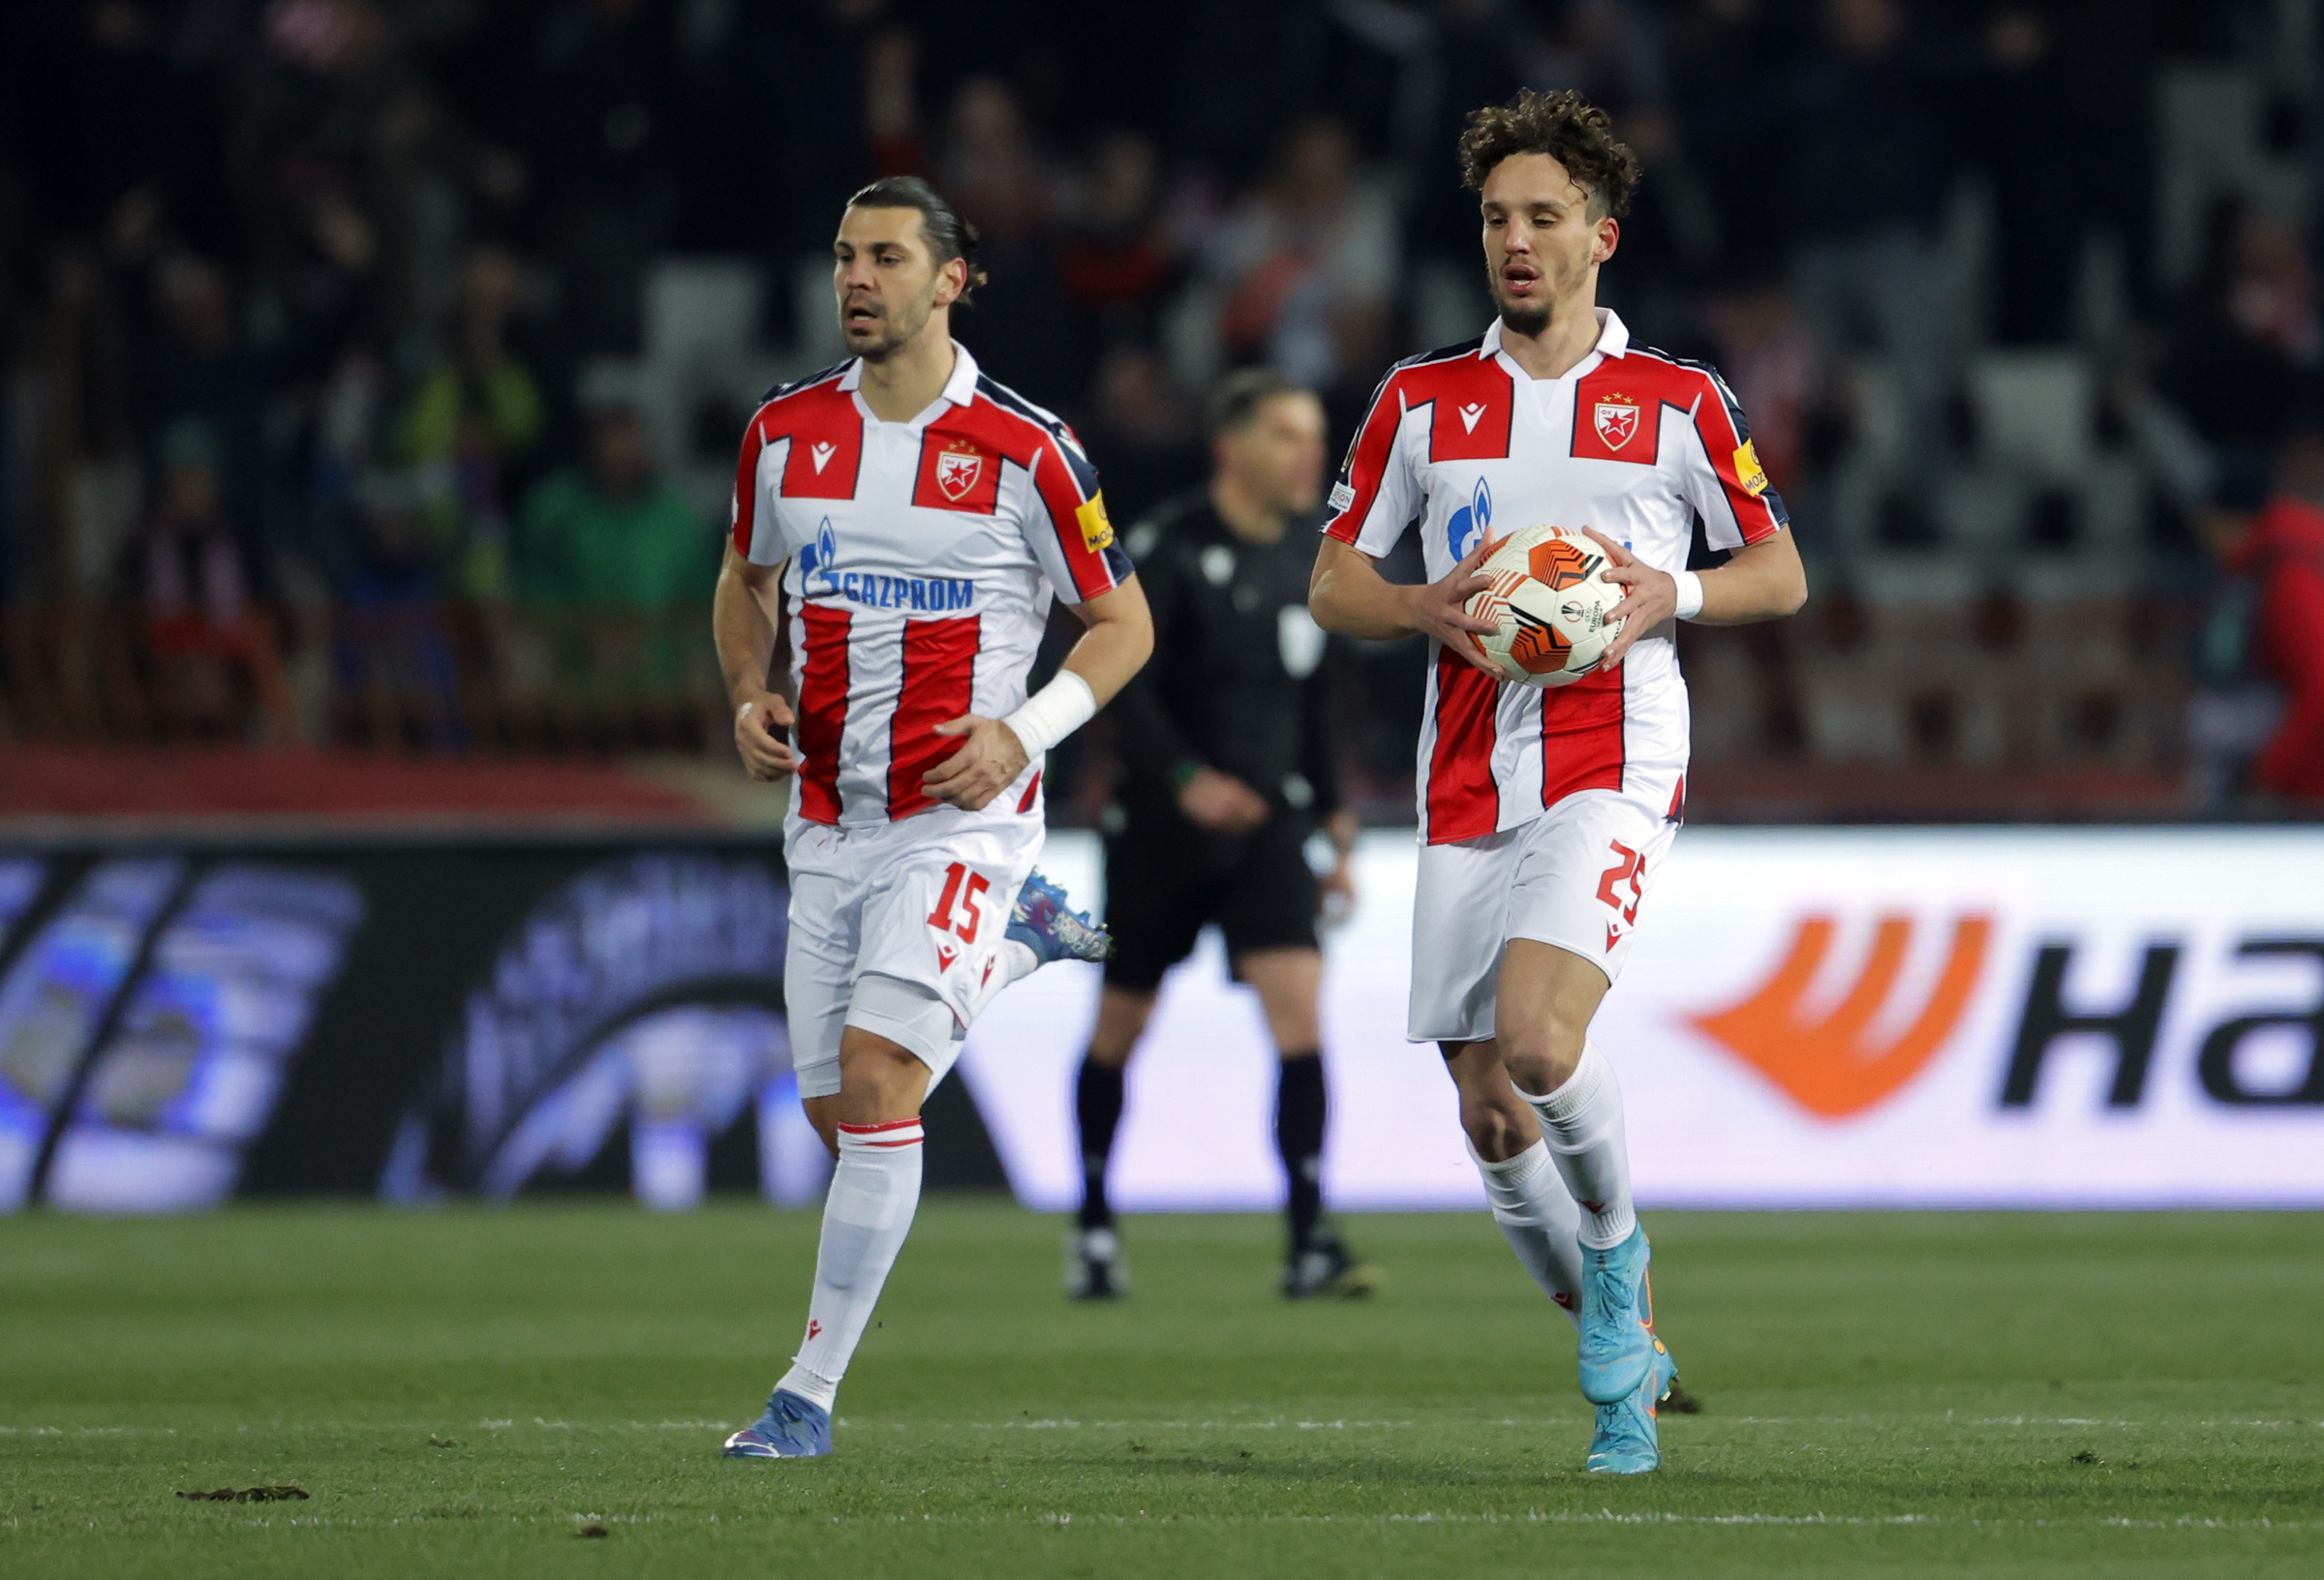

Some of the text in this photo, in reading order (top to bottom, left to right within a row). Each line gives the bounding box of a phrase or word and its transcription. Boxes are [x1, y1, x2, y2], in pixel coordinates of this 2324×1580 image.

[843, 572, 973, 611] GAZPROM
[1589, 600, 1601, 633] EUROPA
[927, 862, 991, 945] 15
[1596, 838, 1646, 927] 25
